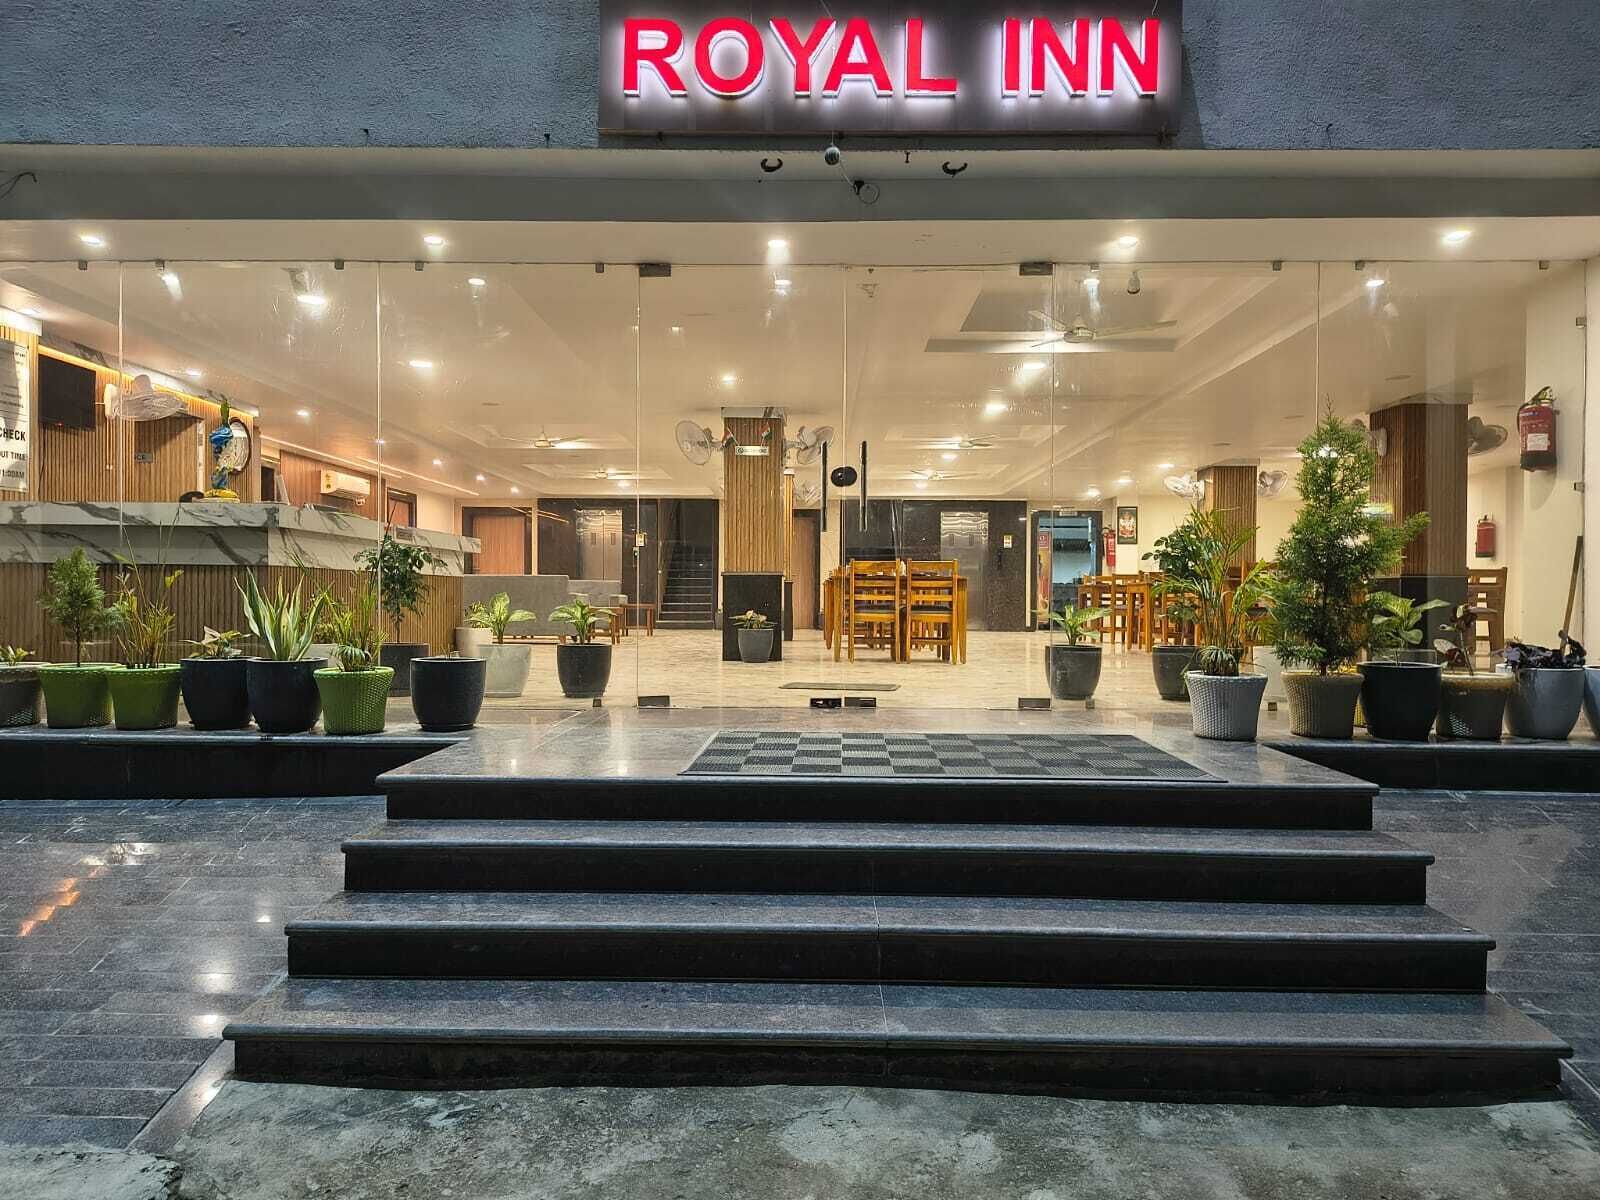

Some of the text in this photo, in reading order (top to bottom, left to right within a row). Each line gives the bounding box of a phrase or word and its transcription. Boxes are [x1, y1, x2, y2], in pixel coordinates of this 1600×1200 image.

[622, 17, 1161, 98] ROYAL INN
[0, 427, 26, 441] CHECK
